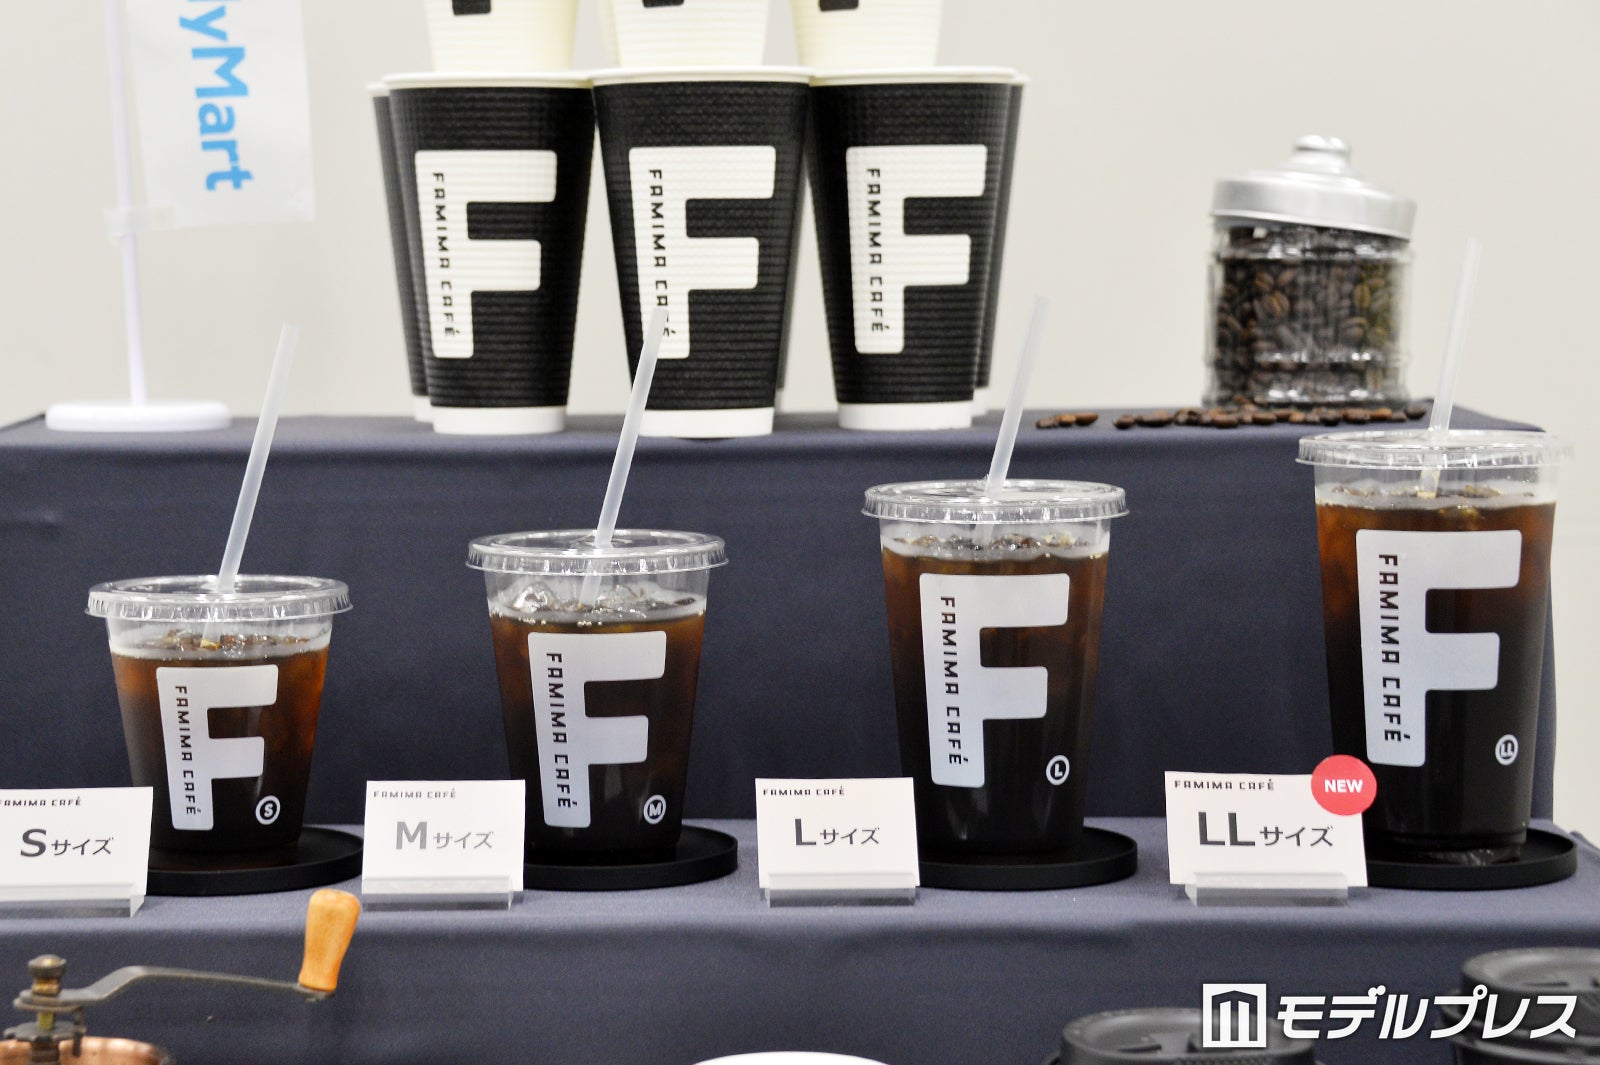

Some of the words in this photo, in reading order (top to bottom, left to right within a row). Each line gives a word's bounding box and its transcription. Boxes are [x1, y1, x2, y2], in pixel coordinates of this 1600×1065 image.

[179, 0, 253, 192] yMart
[432, 172, 450, 269] FAMIMA
[648, 169, 667, 268] FAMIMA
[867, 168, 882, 264] FAMIMA
[440, 280, 461, 337] CAFÉ
[869, 276, 890, 332] CAFÉ
[1378, 554, 1400, 664] FAMIMA
[940, 596, 960, 695] FAMIMA
[175, 685, 193, 761] FAMIMA
[546, 653, 568, 744] FAMIMA
[1382, 676, 1411, 742] CAFÉ
[946, 706, 969, 765] CAFÉ
[0, 799, 46, 807] AMIMA
[51, 796, 81, 807] CAFÉ
[182, 770, 202, 815] CAFÉ
[373, 791, 422, 799] FAMIMA
[426, 788, 456, 799] CAFÉ
[554, 754, 578, 808] CAFÉ
[816, 785, 844, 796] CAFÉ
[1174, 780, 1233, 790] FAMIMA
[1239, 778, 1274, 791] CAFÉ
[1324, 779, 1364, 793] NEW
